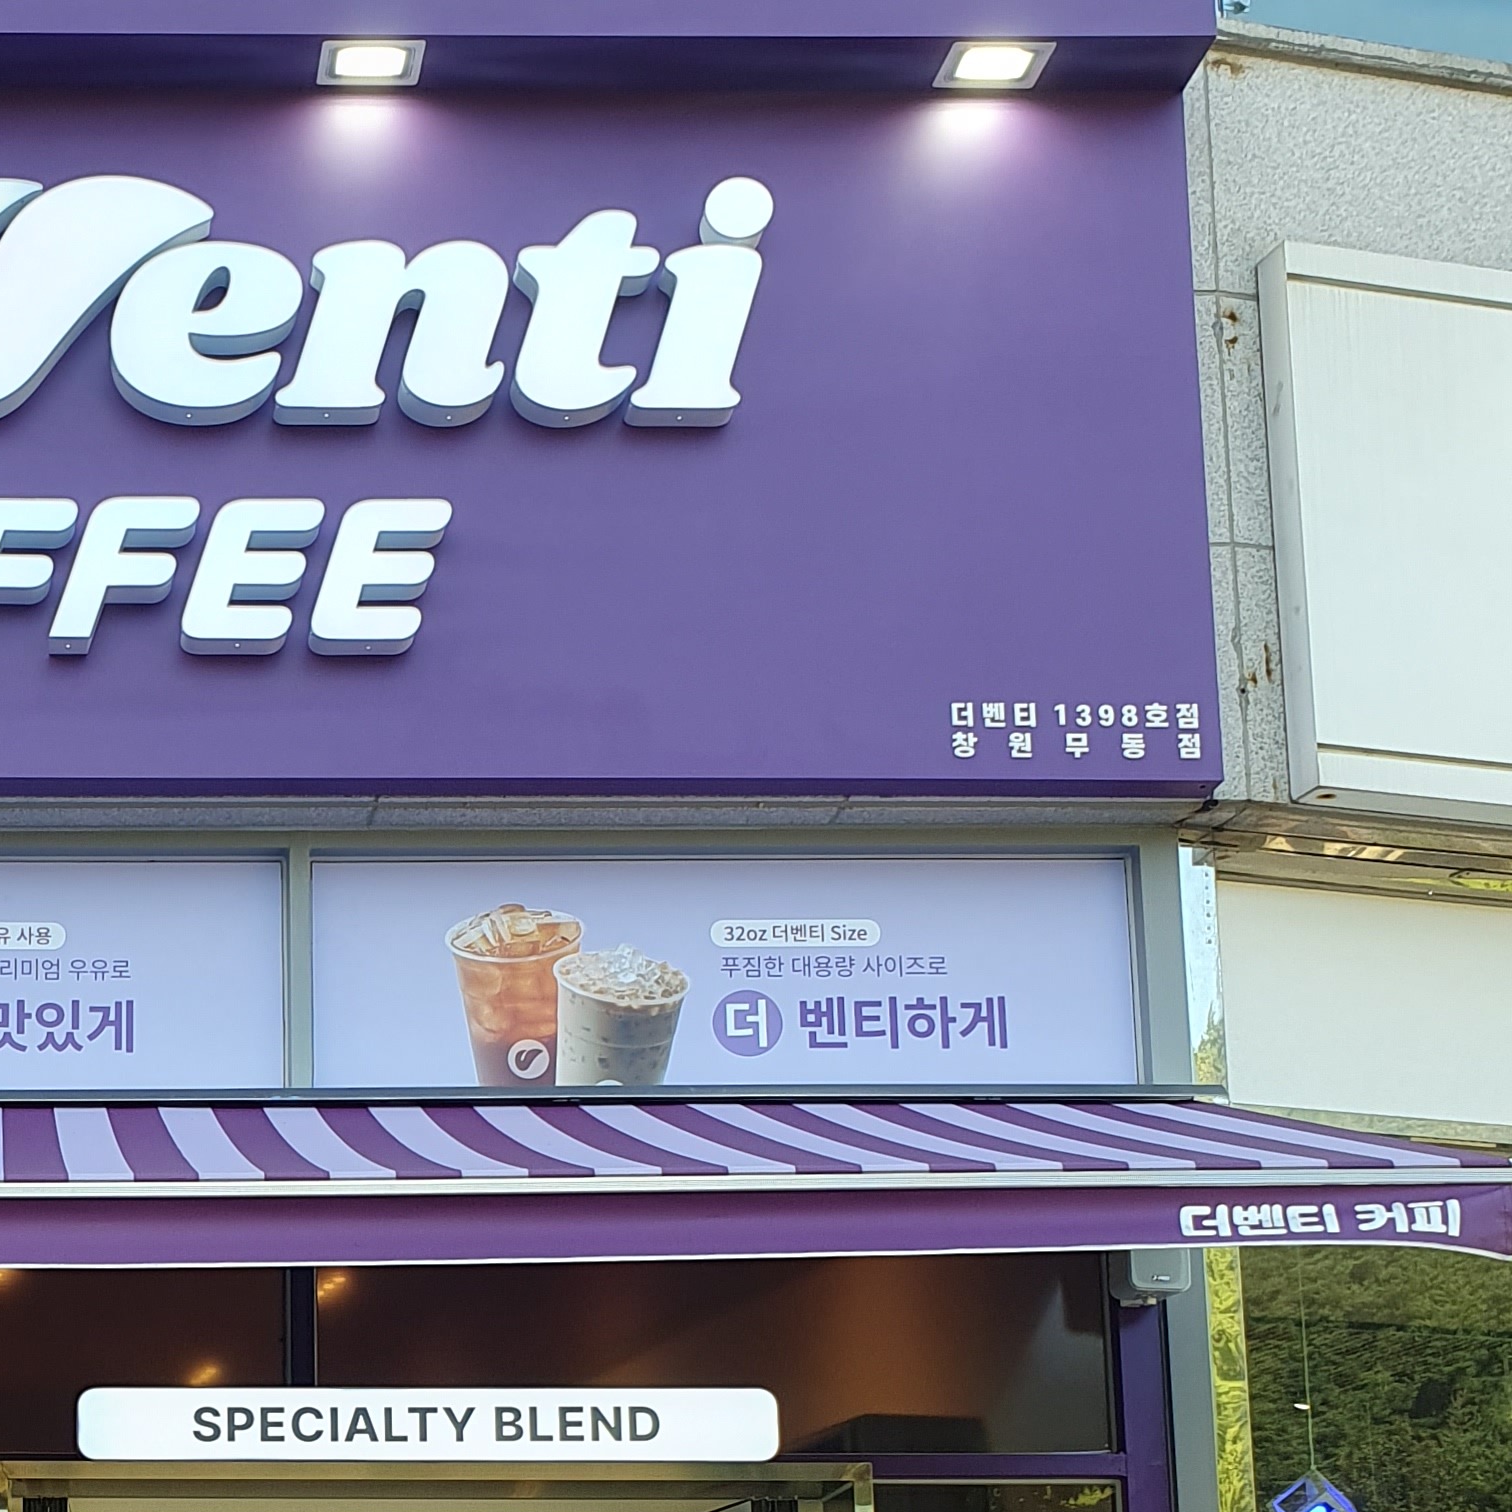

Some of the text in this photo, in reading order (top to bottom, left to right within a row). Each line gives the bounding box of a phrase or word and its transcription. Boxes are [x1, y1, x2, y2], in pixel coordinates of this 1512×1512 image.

[950, 702, 1199, 729] 더벤티 1398호점
[16, 926, 52, 946] 사용
[723, 923, 868, 943] 32oz 더벤티 Size
[67, 959, 131, 981] 우유로
[719, 954, 947, 978] 푸짐한 대용량 사이즈로
[724, 996, 1009, 1050] 더 벤티하게
[1179, 1199, 1461, 1237] 더벤티 커피
[192, 1406, 661, 1444] SPECIALTY BLEND
